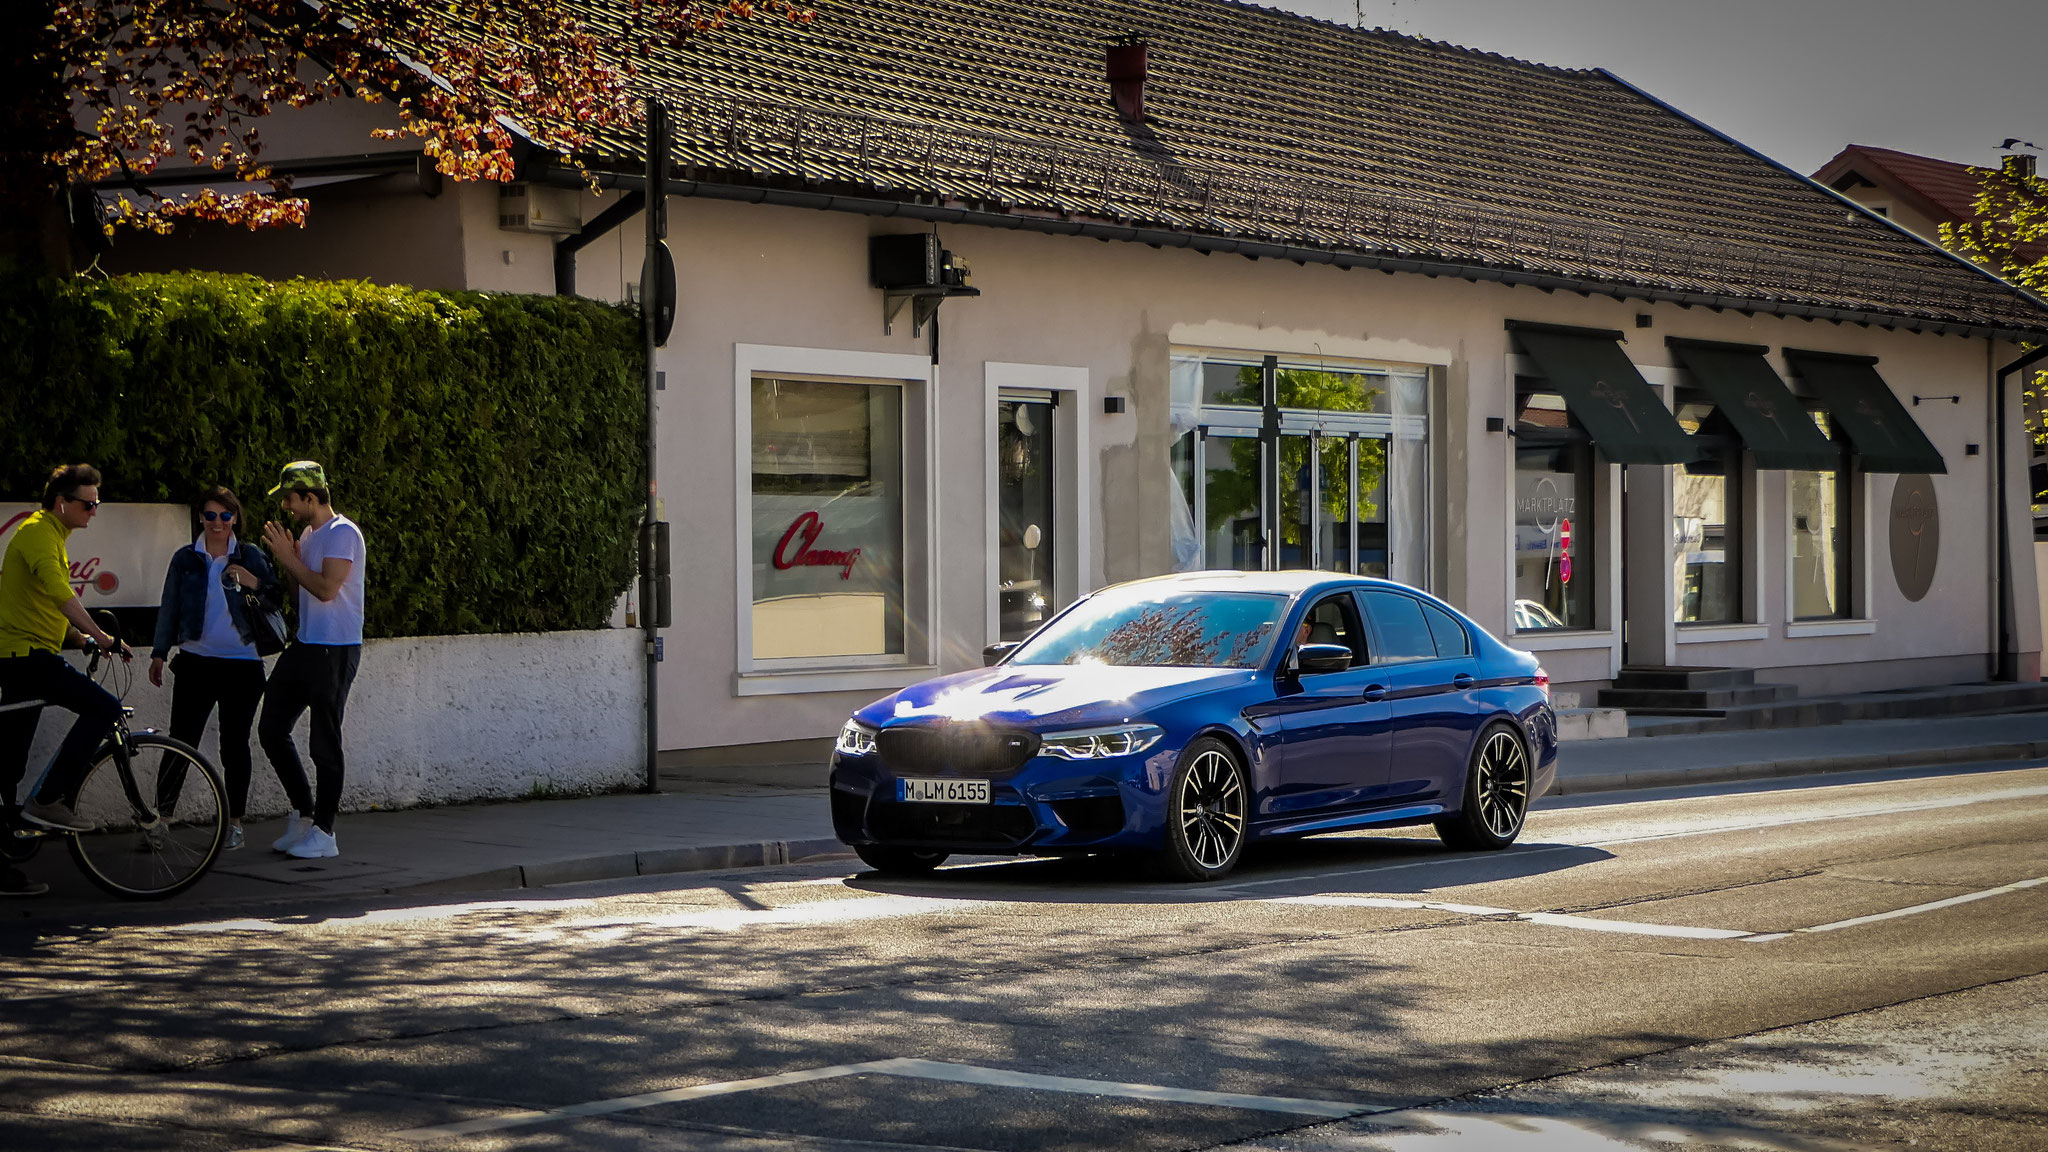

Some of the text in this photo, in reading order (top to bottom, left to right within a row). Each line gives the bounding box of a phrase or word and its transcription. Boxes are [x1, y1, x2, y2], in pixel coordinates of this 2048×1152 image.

[1516, 498, 1575, 513] MARKTPLATZ
[905, 781, 987, 800] M LM 6155
